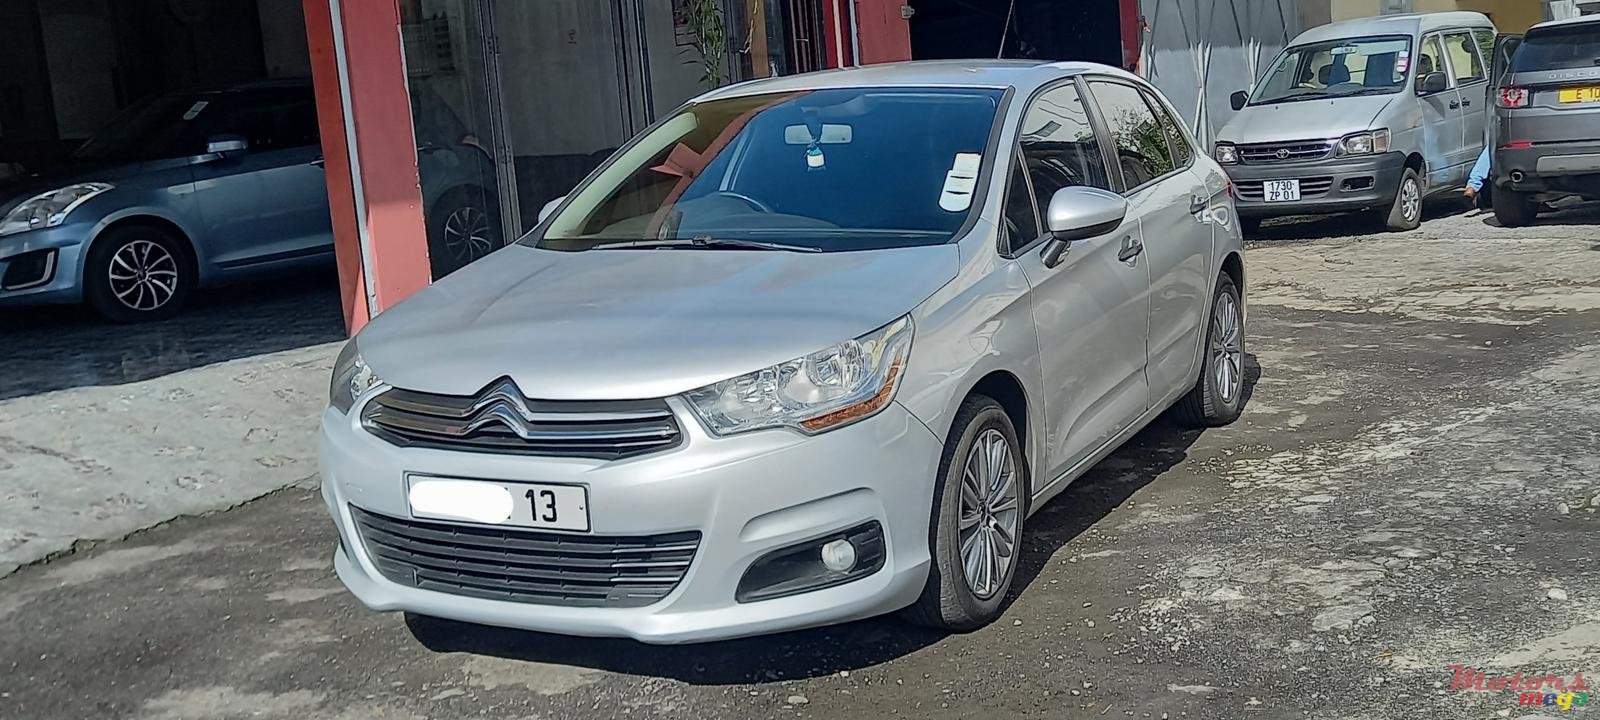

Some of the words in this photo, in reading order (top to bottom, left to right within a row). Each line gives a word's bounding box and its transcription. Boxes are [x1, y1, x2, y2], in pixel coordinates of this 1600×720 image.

[1576, 88, 1583, 100] E
[1271, 181, 1292, 191] 1730
[1270, 191, 1280, 200] ZP
[1283, 190, 1295, 200] 01
[525, 489, 557, 522] 13
